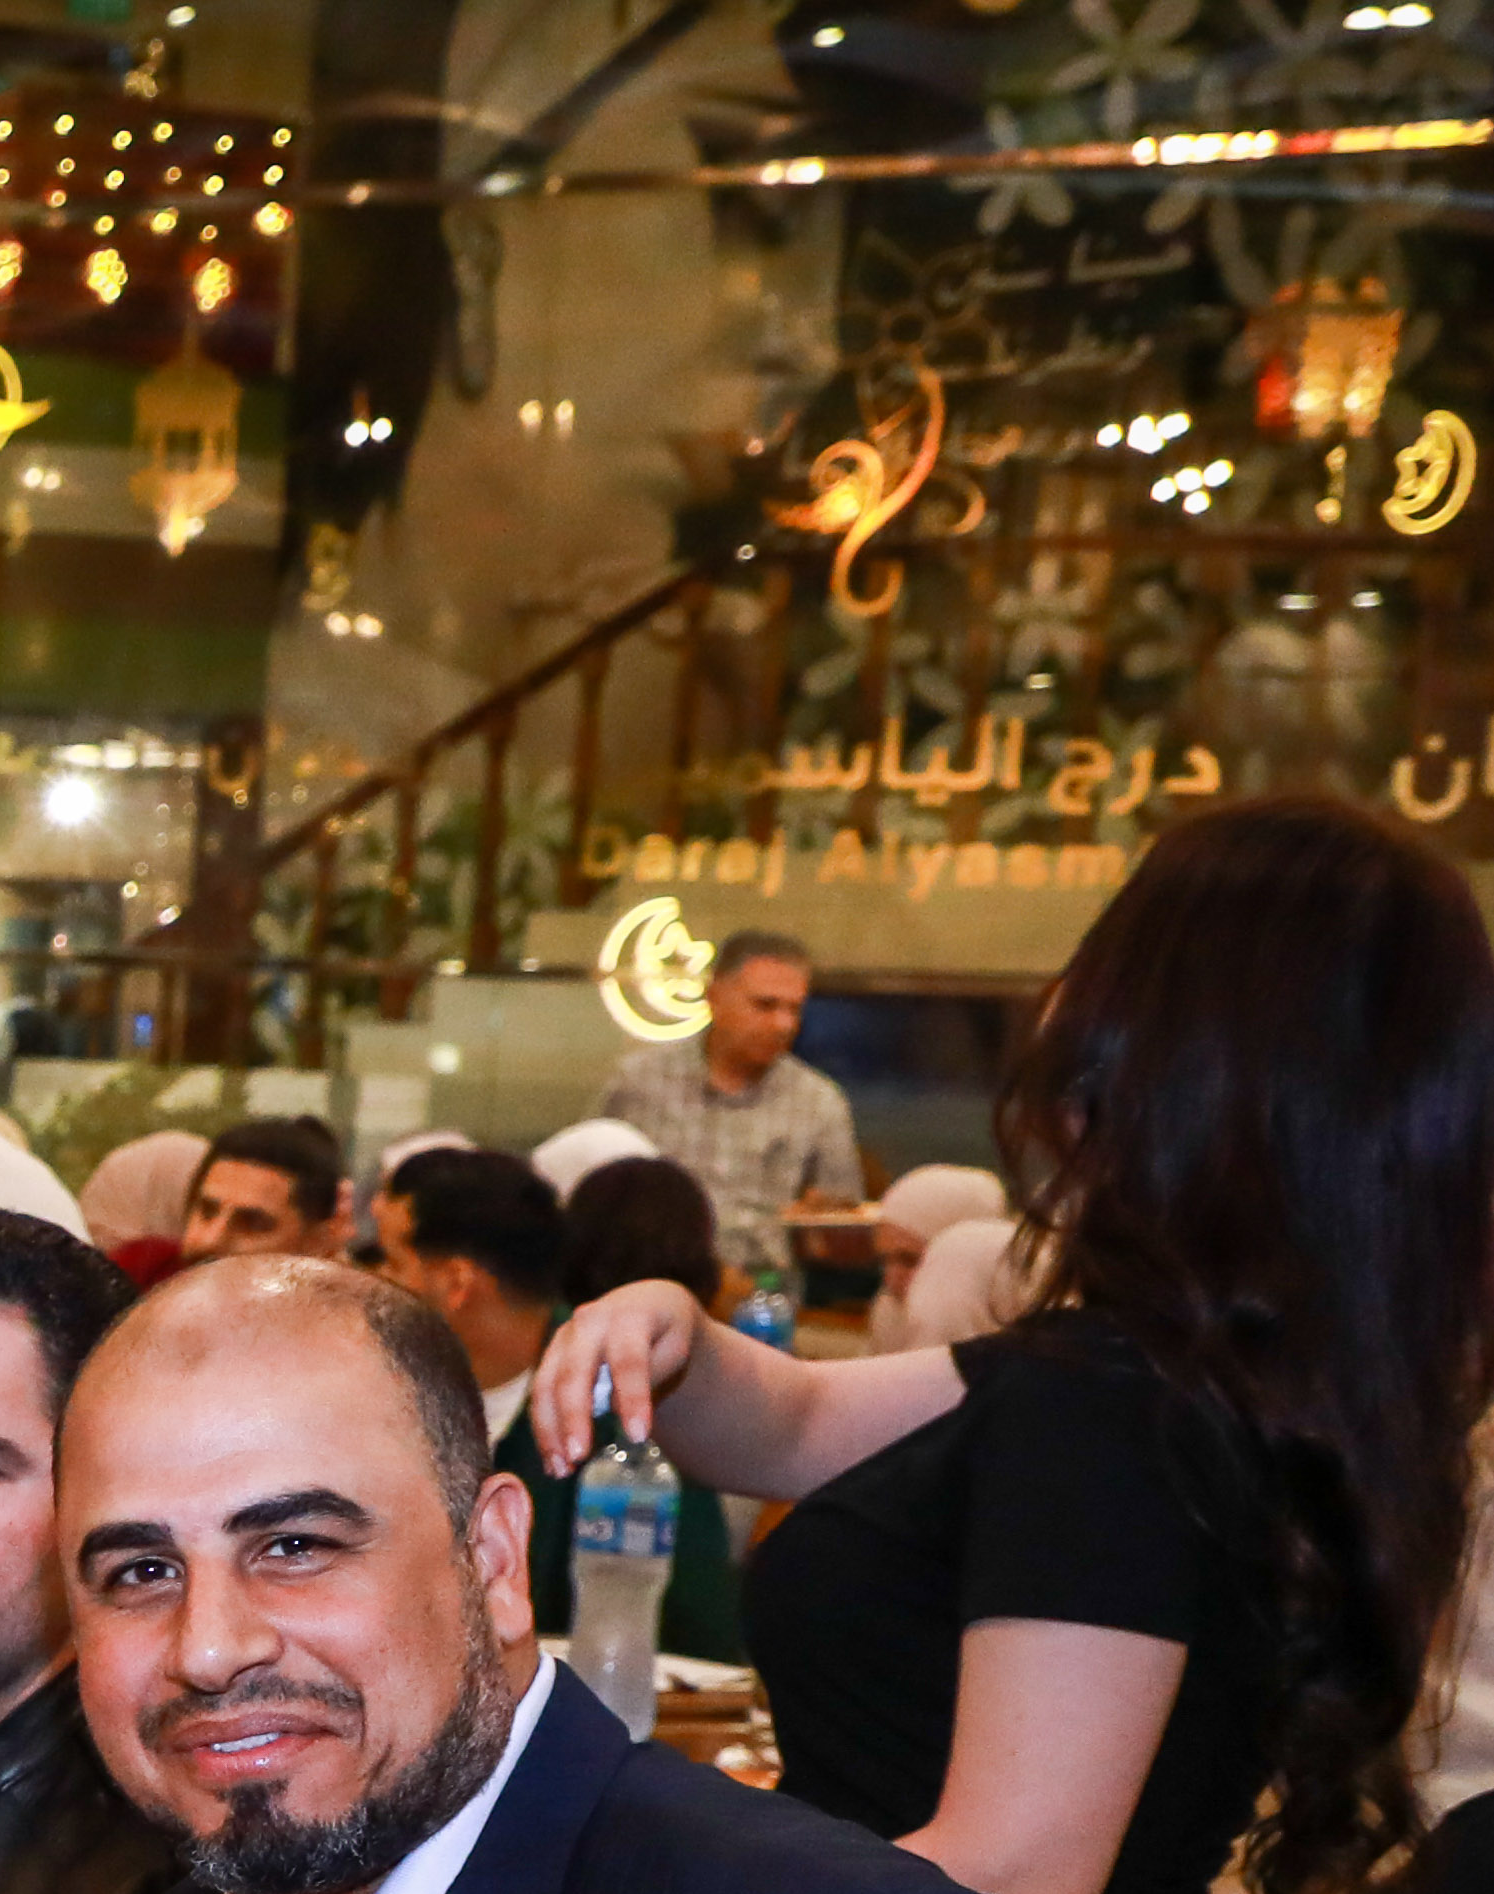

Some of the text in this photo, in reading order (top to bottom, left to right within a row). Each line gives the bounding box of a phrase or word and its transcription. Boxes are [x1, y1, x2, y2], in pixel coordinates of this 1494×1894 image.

[1046, 733, 1223, 817] درج
[580, 824, 1157, 901] Daraj Alyasm
